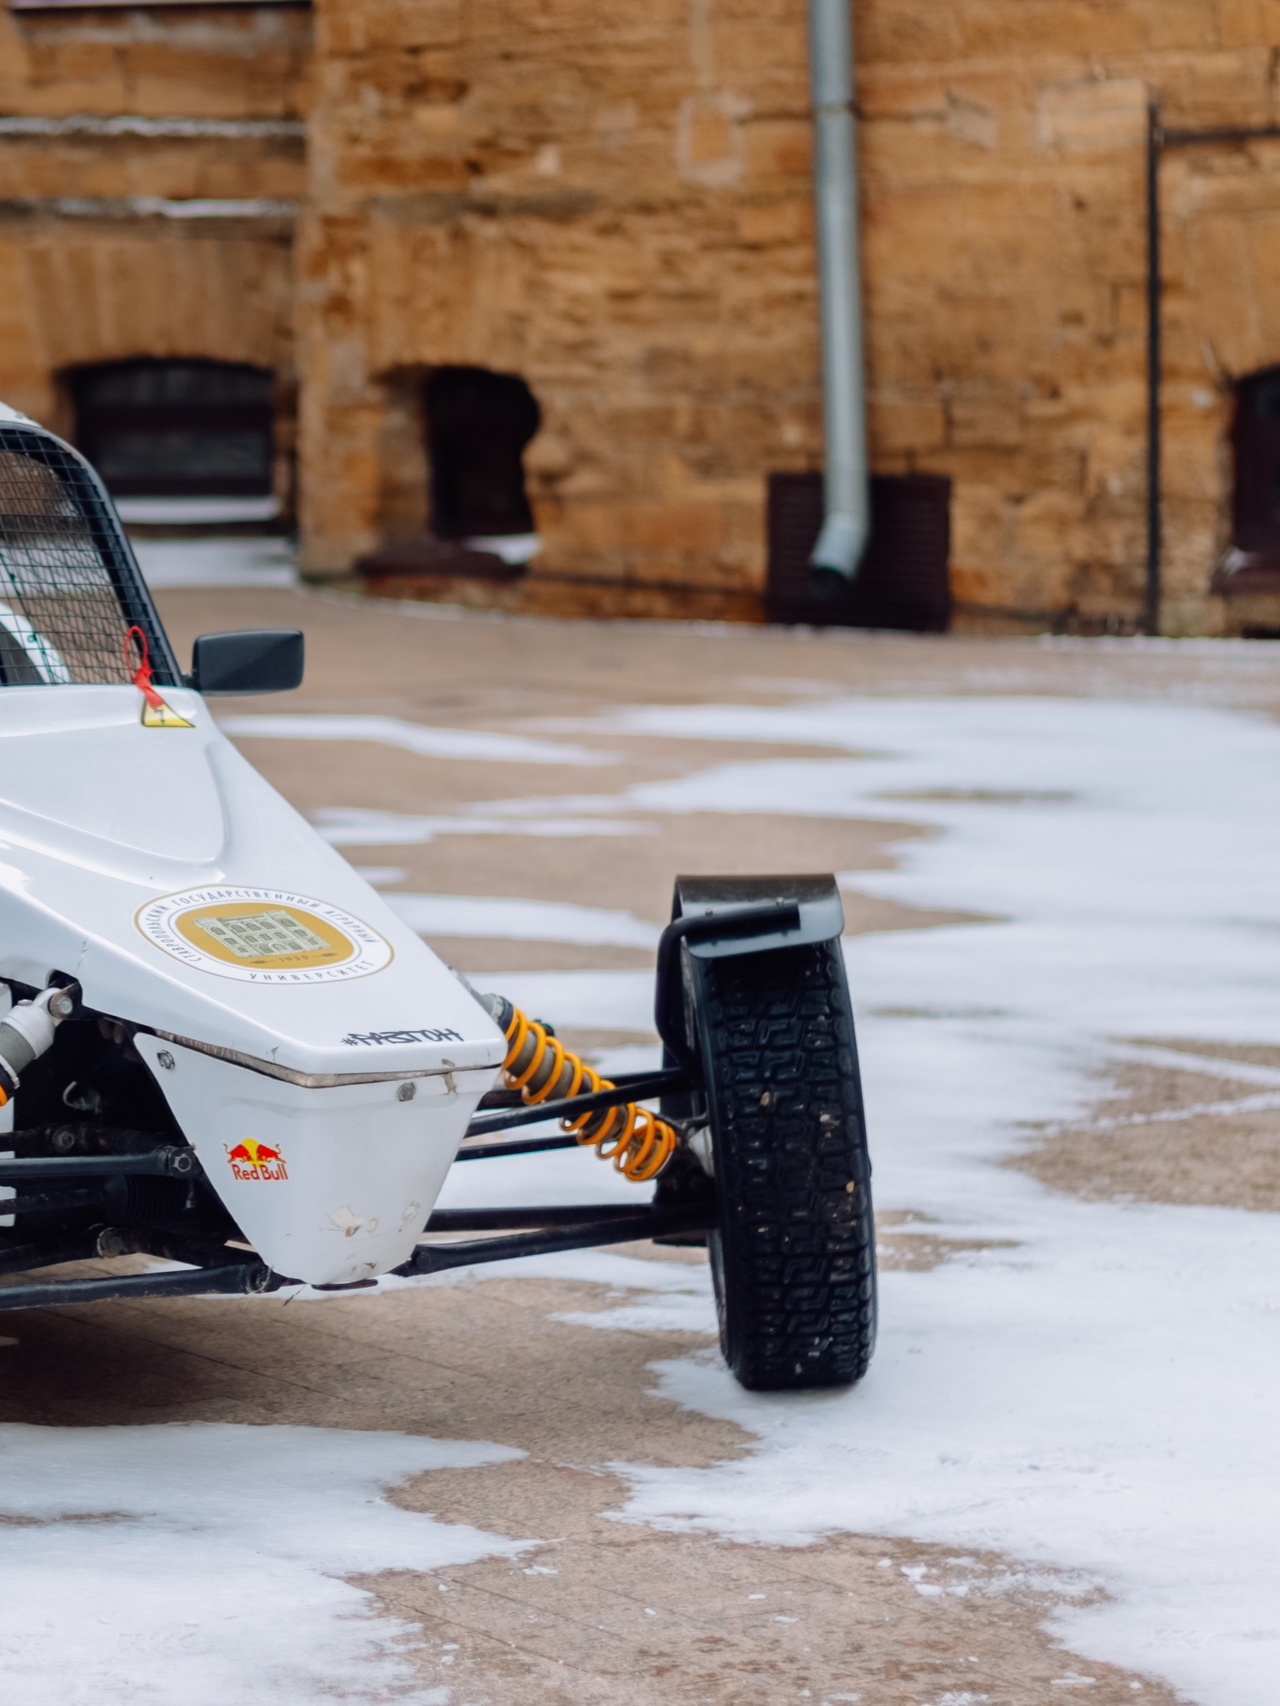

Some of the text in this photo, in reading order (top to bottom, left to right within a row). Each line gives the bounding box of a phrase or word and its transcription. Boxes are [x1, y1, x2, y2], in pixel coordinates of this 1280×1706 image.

[145, 890, 380, 962] СТАВРОПОЛЬСКИЙ ГОСУДАРСТВЕННЫЙ АГРАРНЫЙ
[249, 960, 376, 981] УНИВЕРСИТЕТ
[231, 1164, 288, 1180] Red Bull
